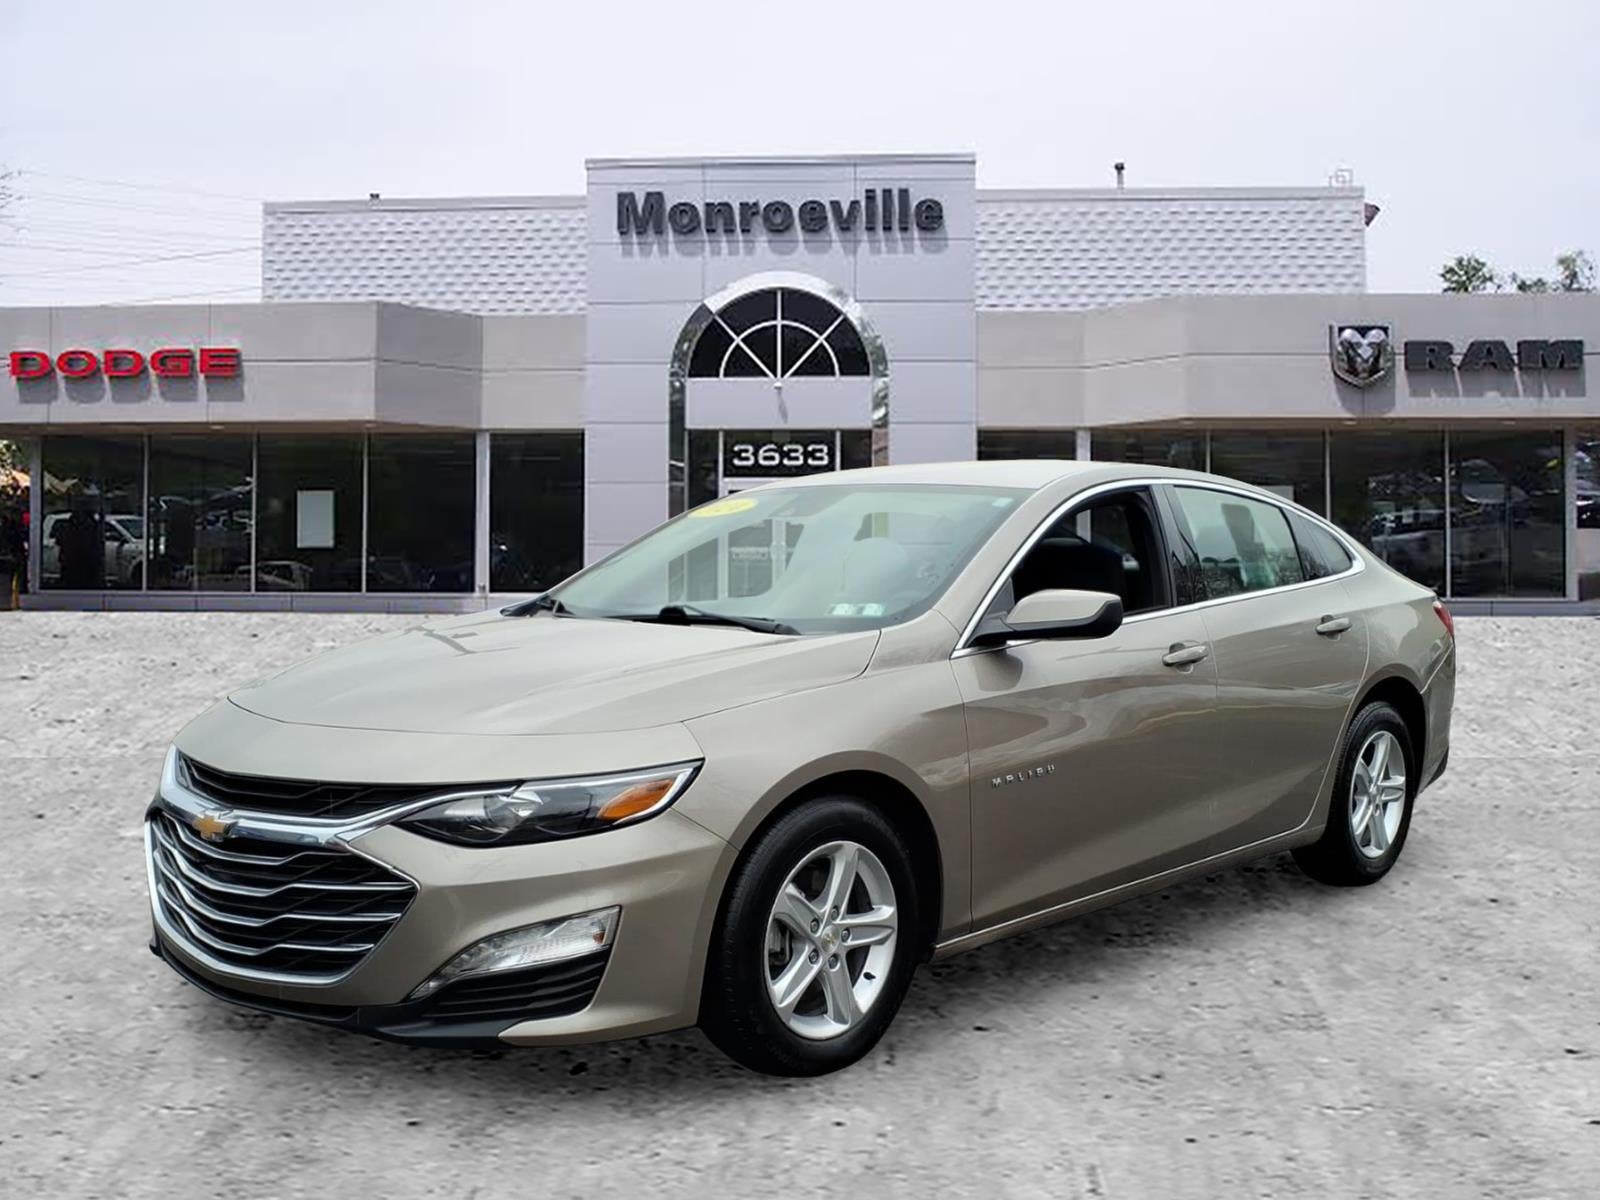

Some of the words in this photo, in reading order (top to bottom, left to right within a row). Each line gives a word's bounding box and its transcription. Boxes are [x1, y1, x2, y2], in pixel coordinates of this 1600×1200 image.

[617, 188, 943, 235] Monroeville
[9, 348, 240, 377] DODGE
[1404, 340, 1584, 371] RAM
[733, 444, 829, 466] 3633
